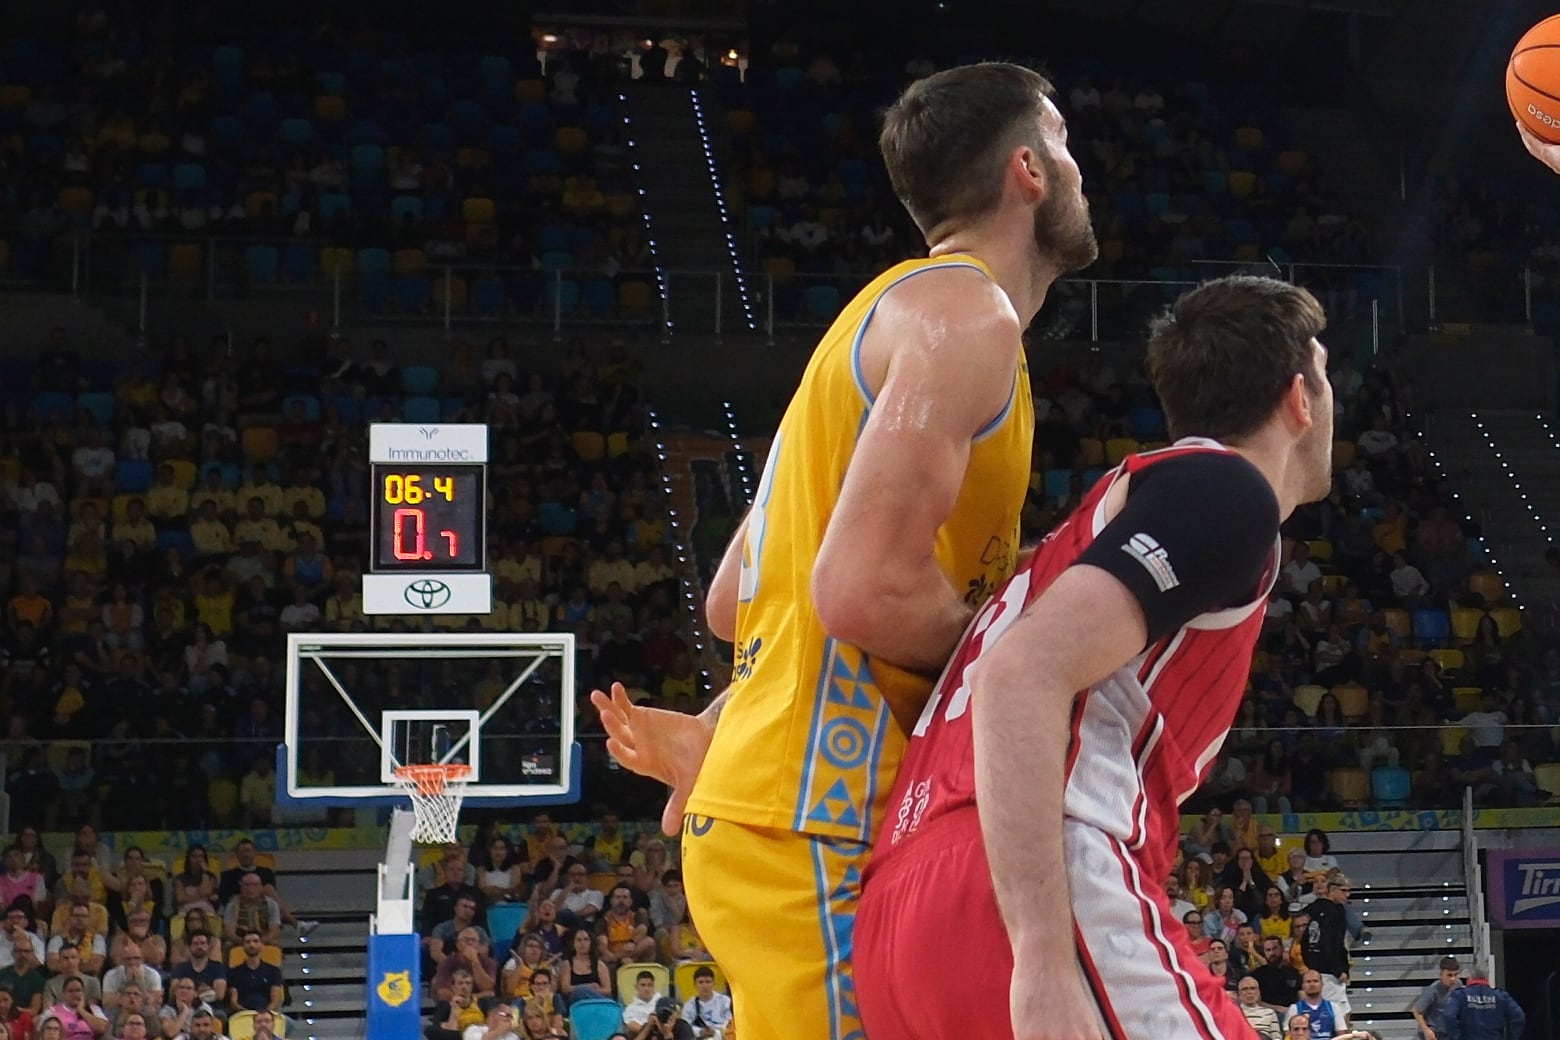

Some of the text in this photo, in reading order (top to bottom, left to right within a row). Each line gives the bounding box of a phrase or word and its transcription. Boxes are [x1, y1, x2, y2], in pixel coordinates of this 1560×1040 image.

[388, 447, 471, 460] Immunotec
[385, 474, 454, 504] 06.4
[393, 508, 458, 560] 0.7
